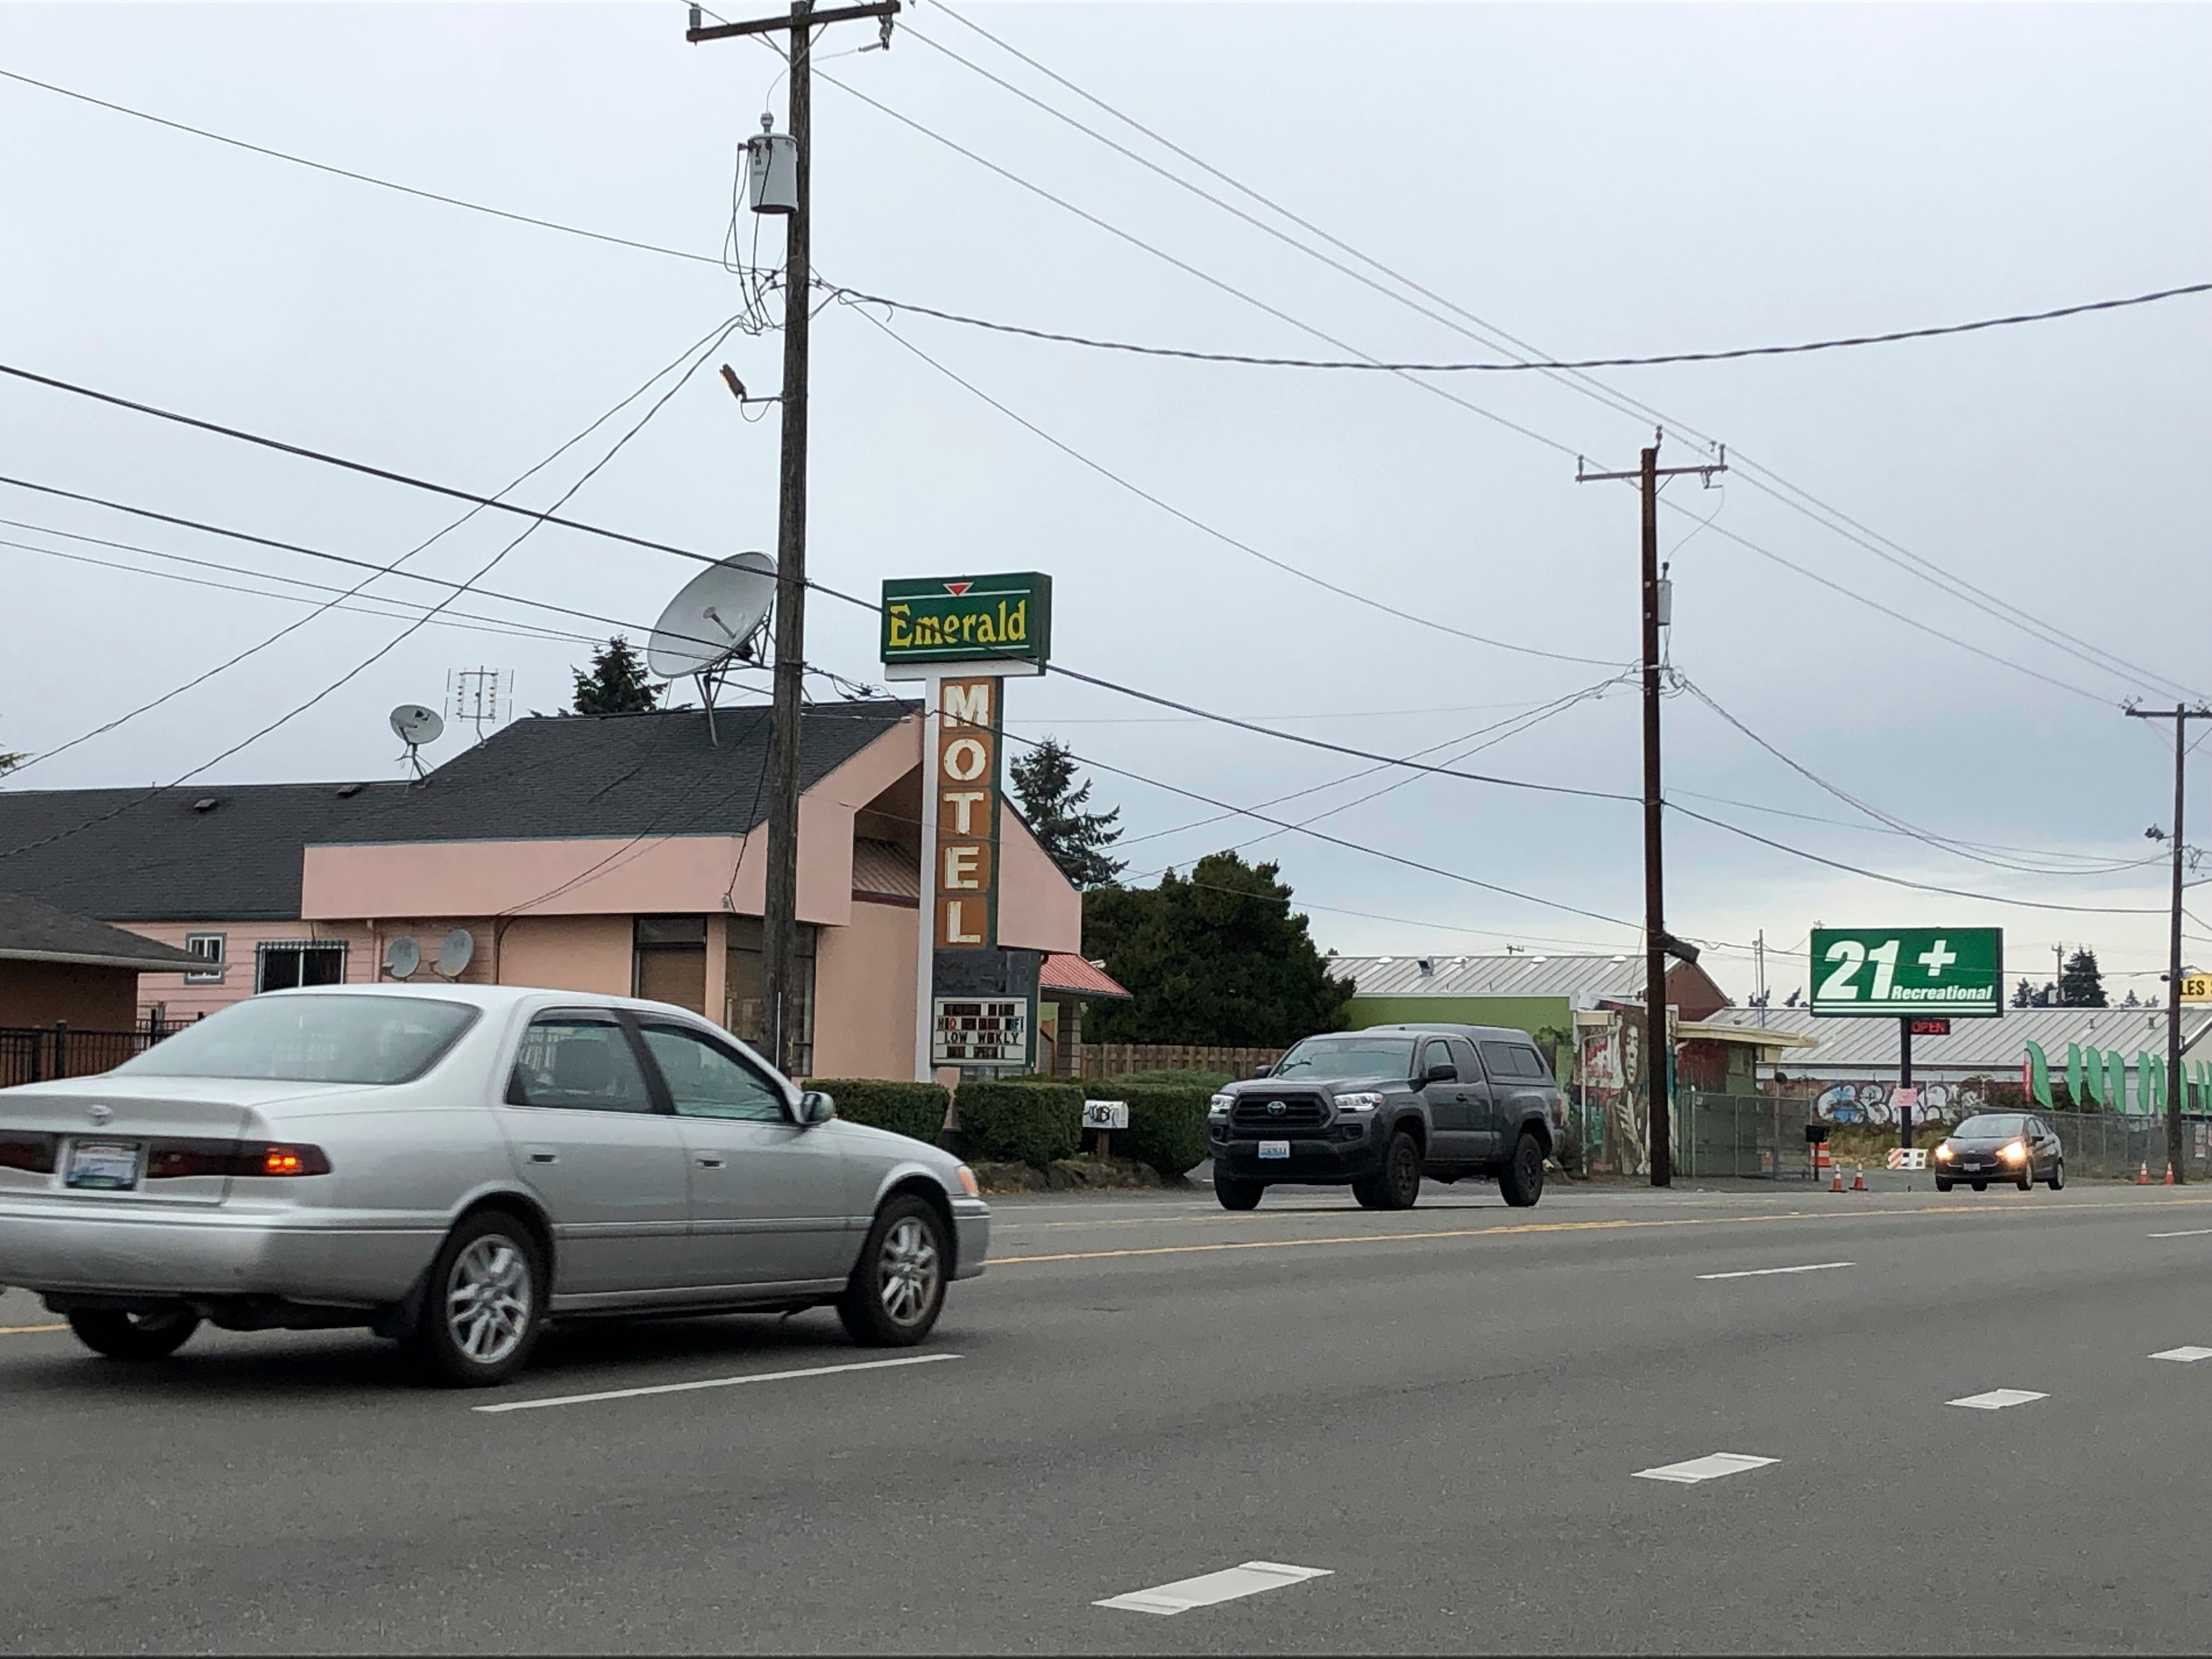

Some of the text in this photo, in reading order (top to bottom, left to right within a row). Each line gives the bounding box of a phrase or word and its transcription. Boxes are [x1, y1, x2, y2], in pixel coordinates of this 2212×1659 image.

[889, 600, 1026, 647] Emerald
[944, 684, 989, 944] MOTEL
[1816, 940, 1900, 1000] 21
[1891, 985, 1994, 1000] Recreational
[945, 1031, 968, 1043] LOW
